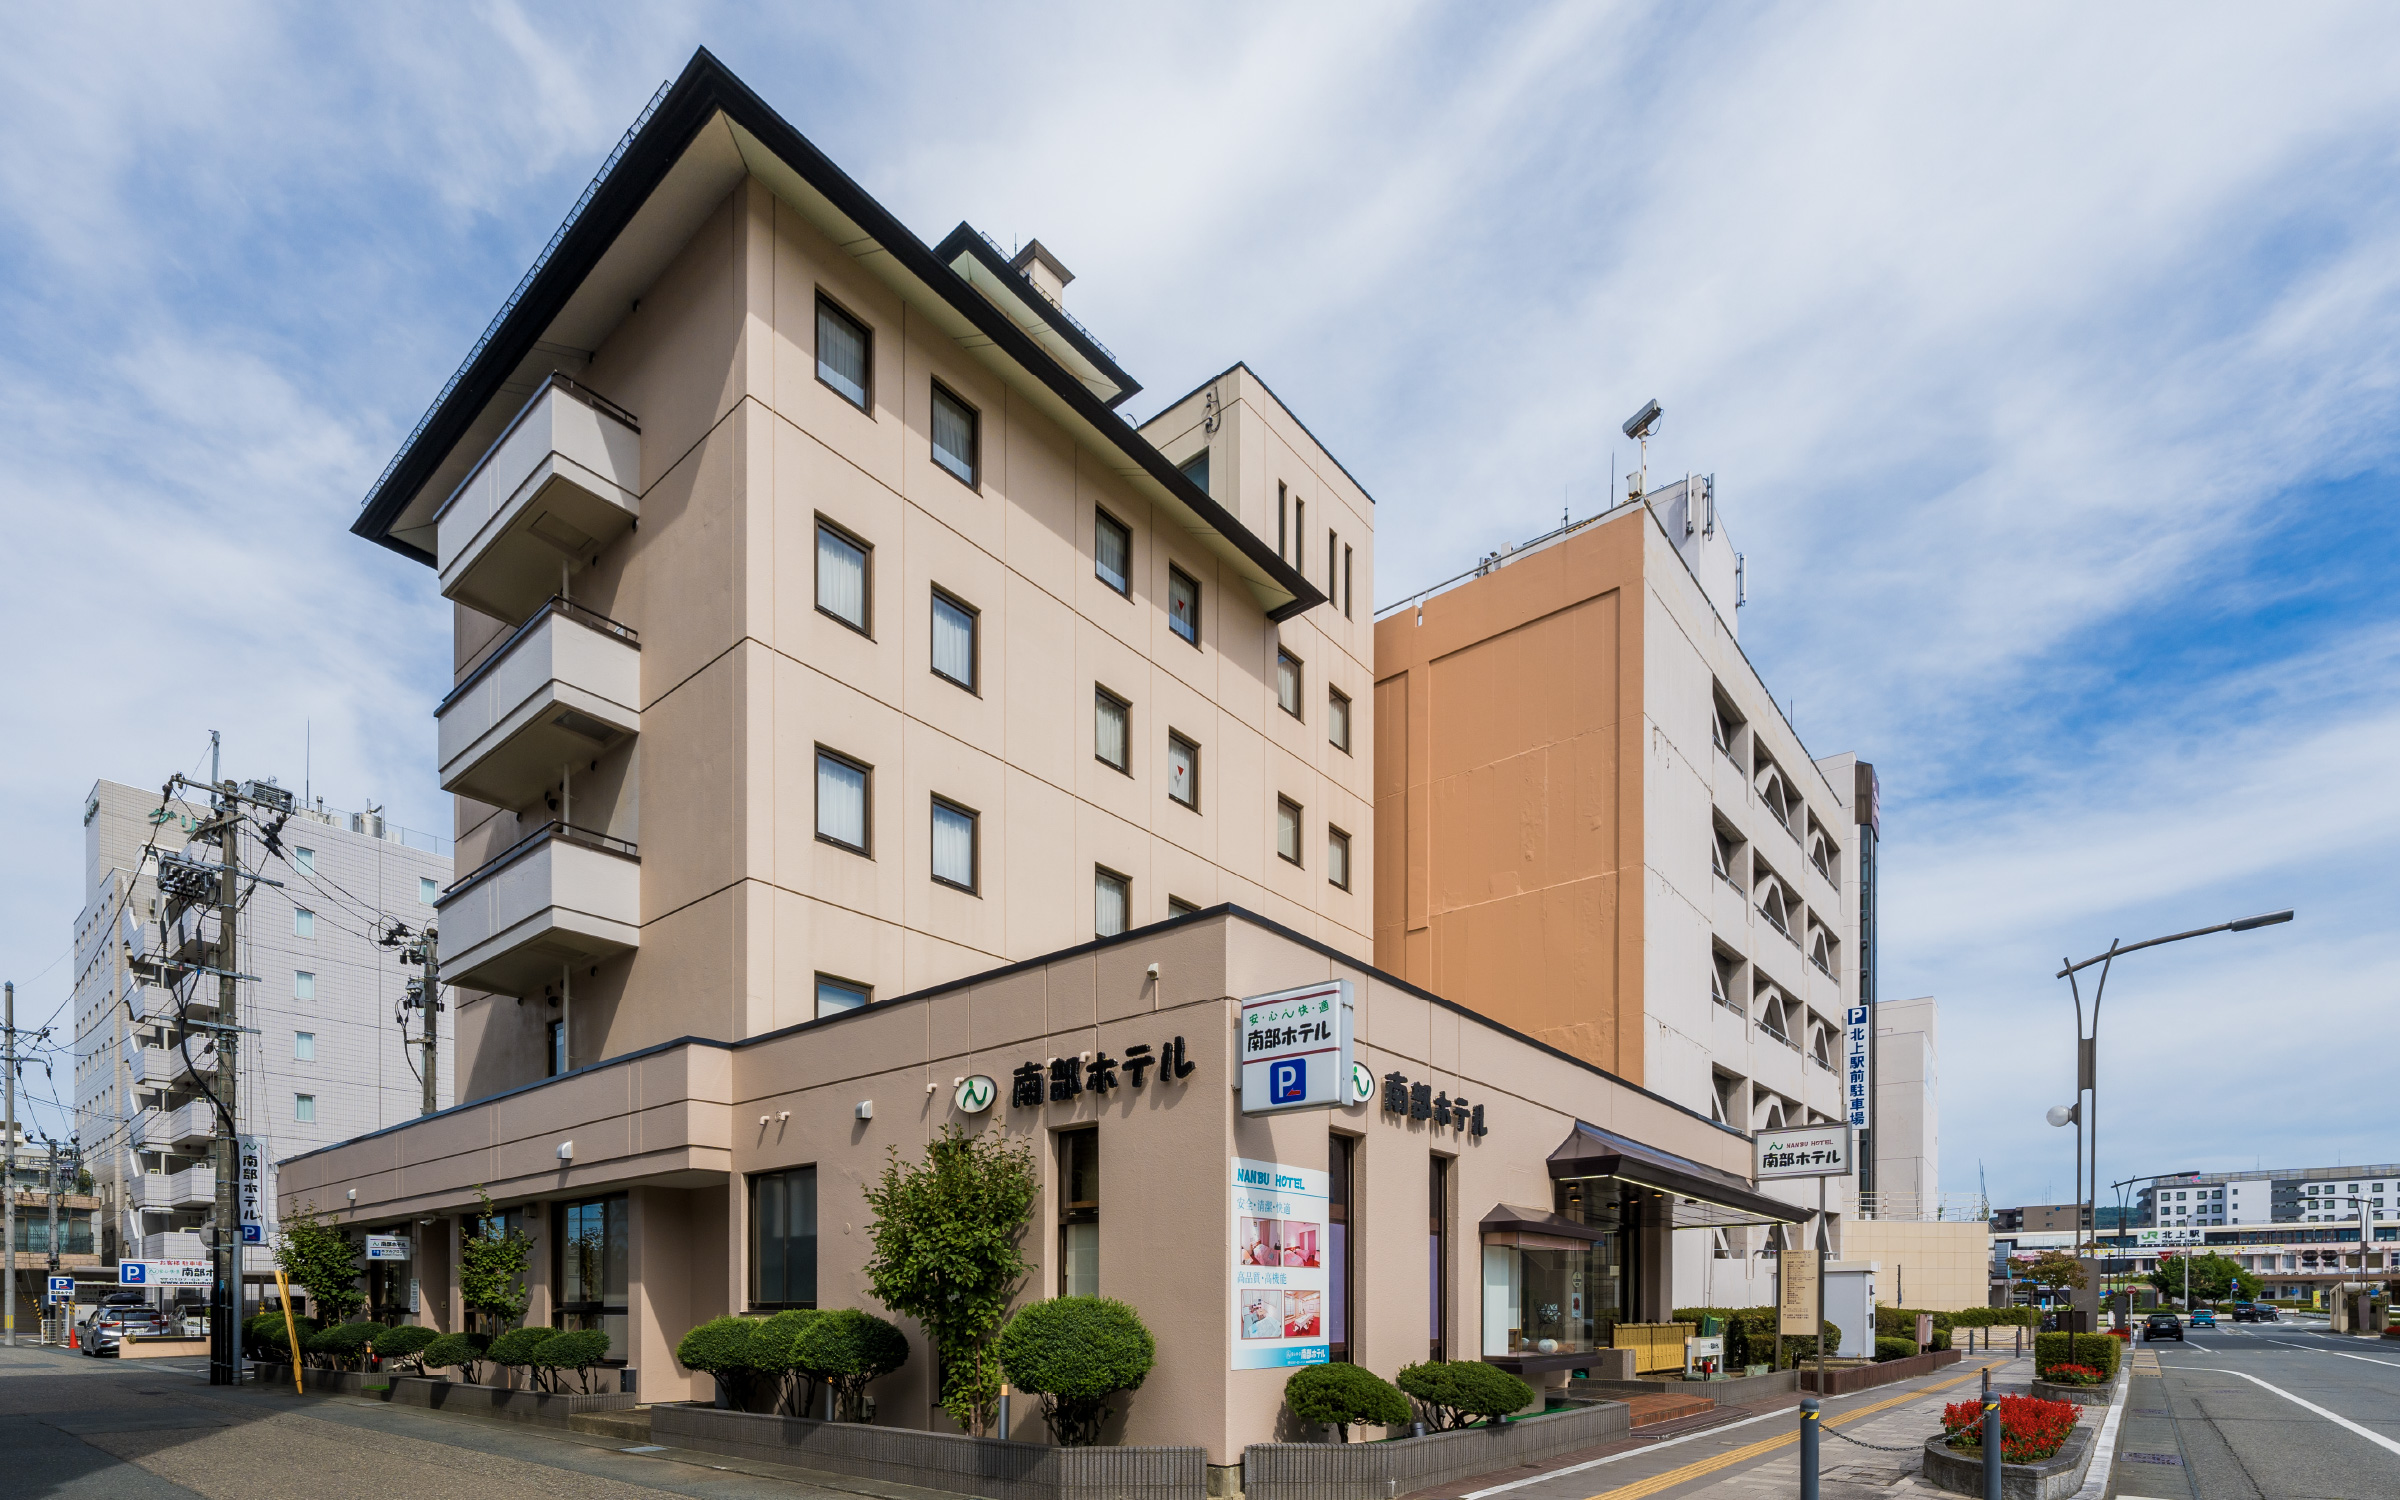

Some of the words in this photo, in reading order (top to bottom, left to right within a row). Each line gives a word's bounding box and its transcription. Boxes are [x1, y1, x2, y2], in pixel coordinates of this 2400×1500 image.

[1851, 1008, 1863, 1024] P
[1247, 1020, 1331, 1052] 南部ホテル
[1012, 1036, 1196, 1108] 南部ホテル
[1850, 1028, 1865, 1126] 北上駅前駐車場
[1278, 1066, 1297, 1098] P
[1385, 1071, 1488, 1137] 南部ホテル
[1786, 1141, 1809, 1149] NANBU
[1762, 1150, 1841, 1169] 南部ホテル
[243, 1154, 258, 1220] 南部ホテル
[1237, 1168, 1270, 1186] NANBU
[1275, 1173, 1306, 1190] HOTEL
[244, 1227, 256, 1239] P
[2141, 1231, 2158, 1240] JR
[2162, 1229, 2200, 1239] 北上駅
[126, 1265, 140, 1281] P
[55, 1279, 68, 1289] P
